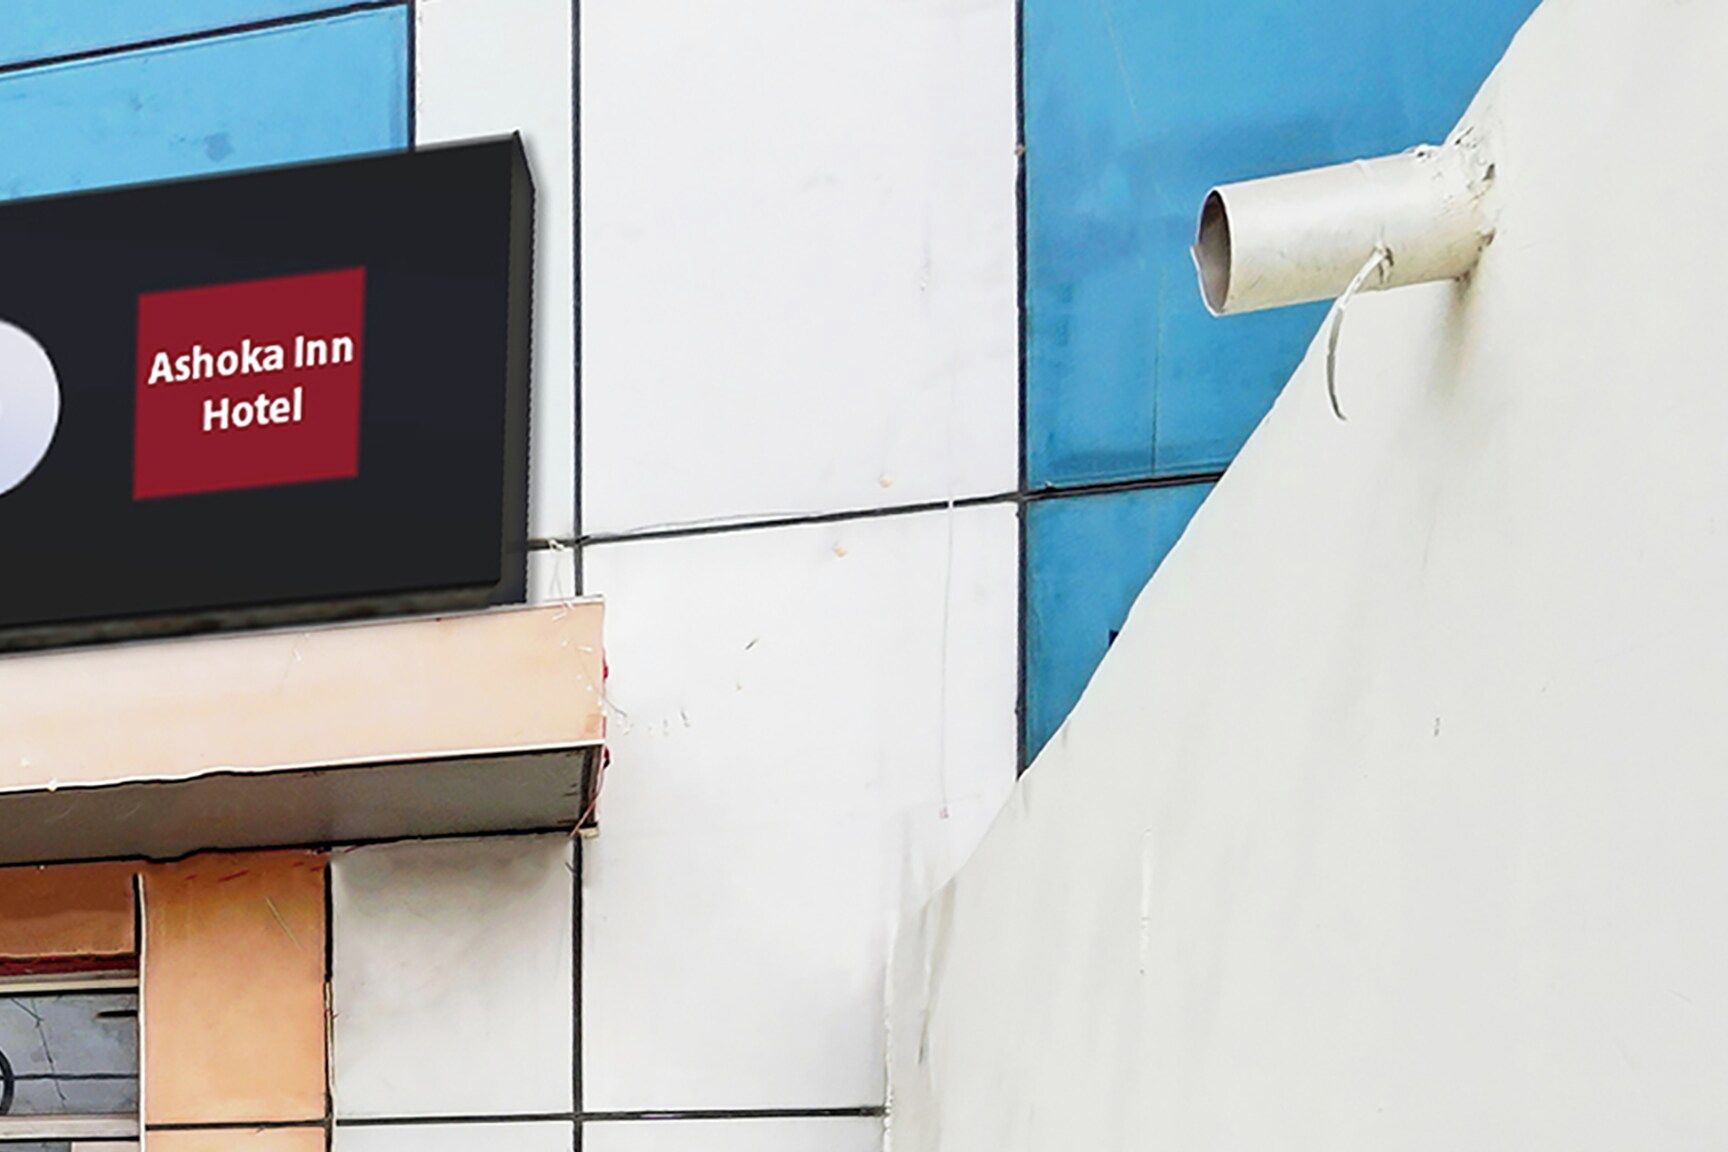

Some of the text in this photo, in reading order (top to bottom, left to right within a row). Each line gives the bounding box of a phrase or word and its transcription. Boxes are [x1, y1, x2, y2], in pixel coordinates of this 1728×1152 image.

[147, 335, 354, 385] Ashoka Inn
[202, 386, 303, 432] Hotel
